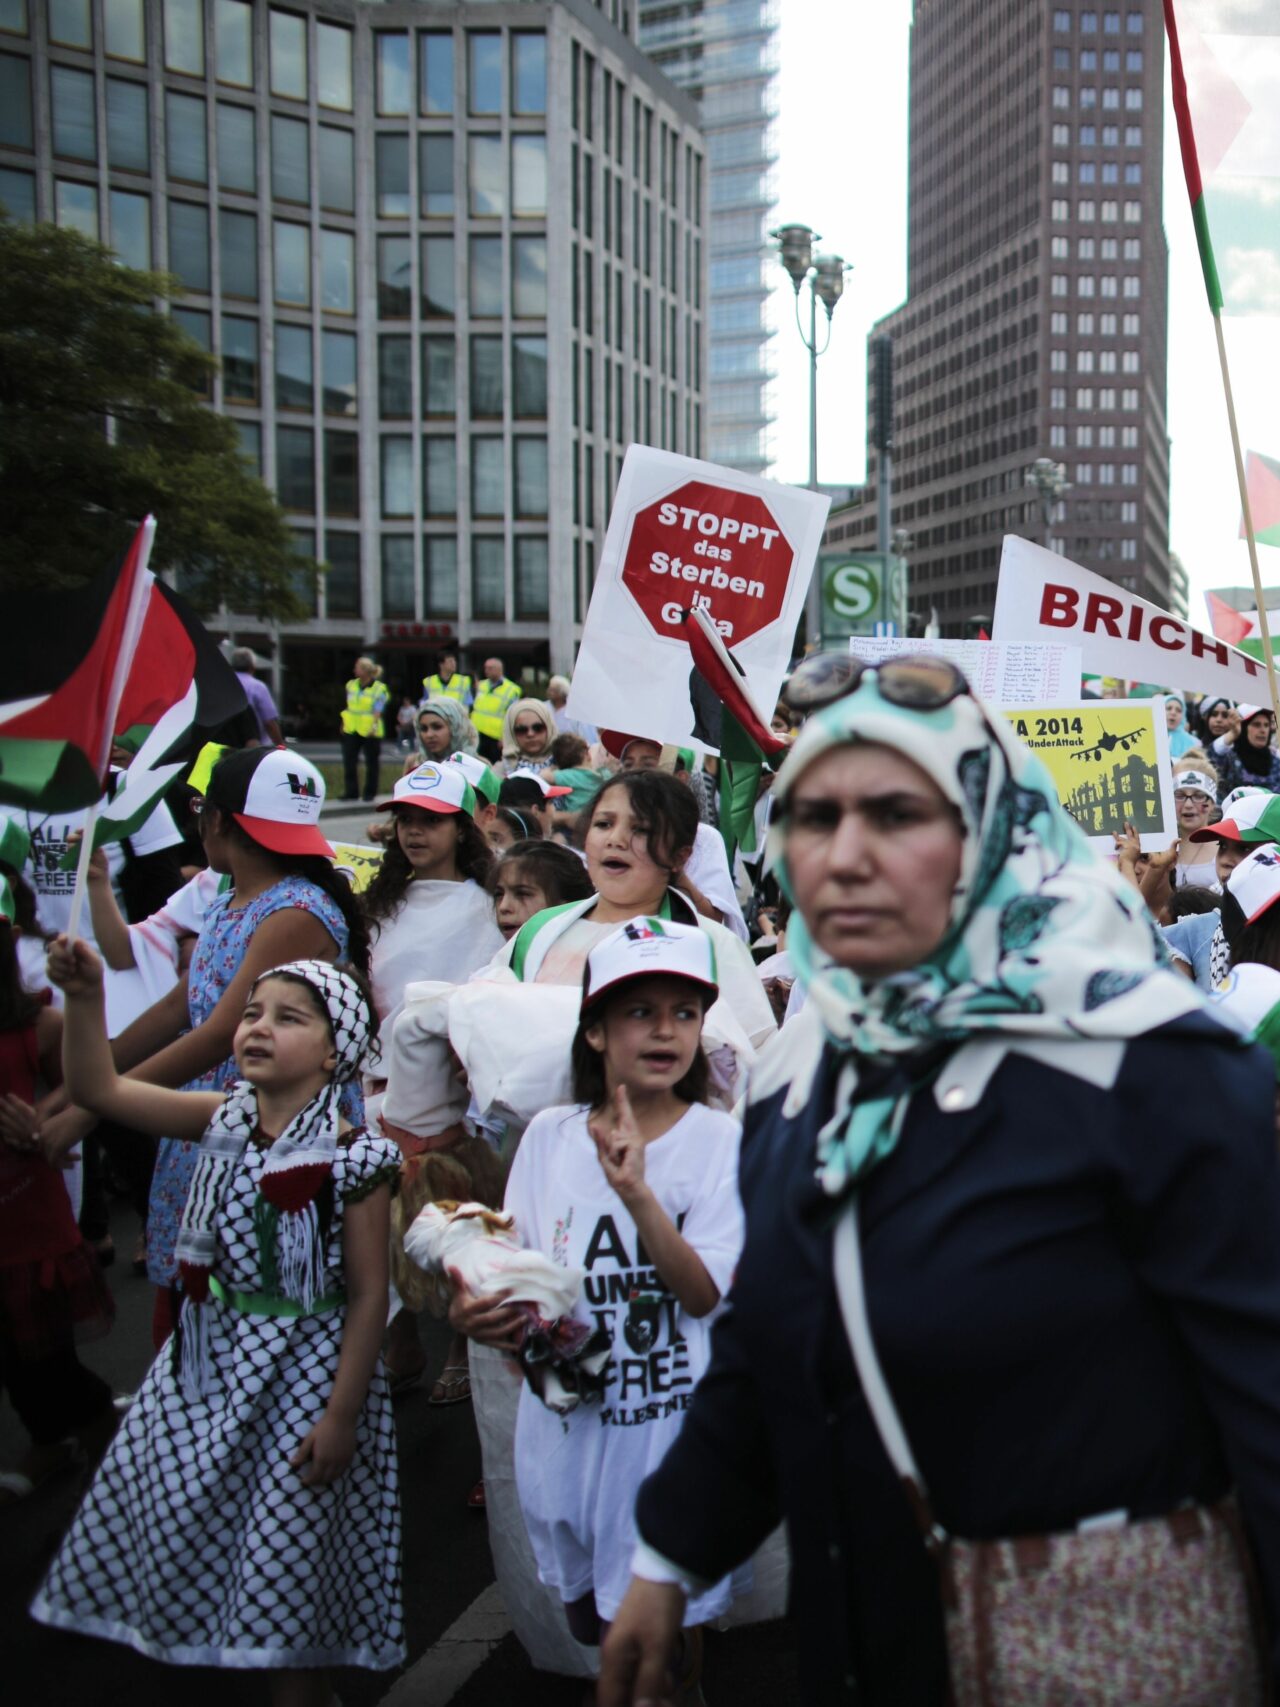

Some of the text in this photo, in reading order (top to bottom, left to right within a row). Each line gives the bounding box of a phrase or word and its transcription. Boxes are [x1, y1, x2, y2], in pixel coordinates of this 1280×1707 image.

[657, 502, 780, 551] STOPPT
[693, 539, 732, 562] das
[649, 551, 765, 599] Sterben
[832, 565, 873, 617] S
[691, 590, 712, 609] in
[661, 602, 734, 638] Ga
[1038, 581, 1267, 677] BRICHT
[1025, 737, 1085, 749] UnderAttack
[1035, 716, 1084, 736] 2014
